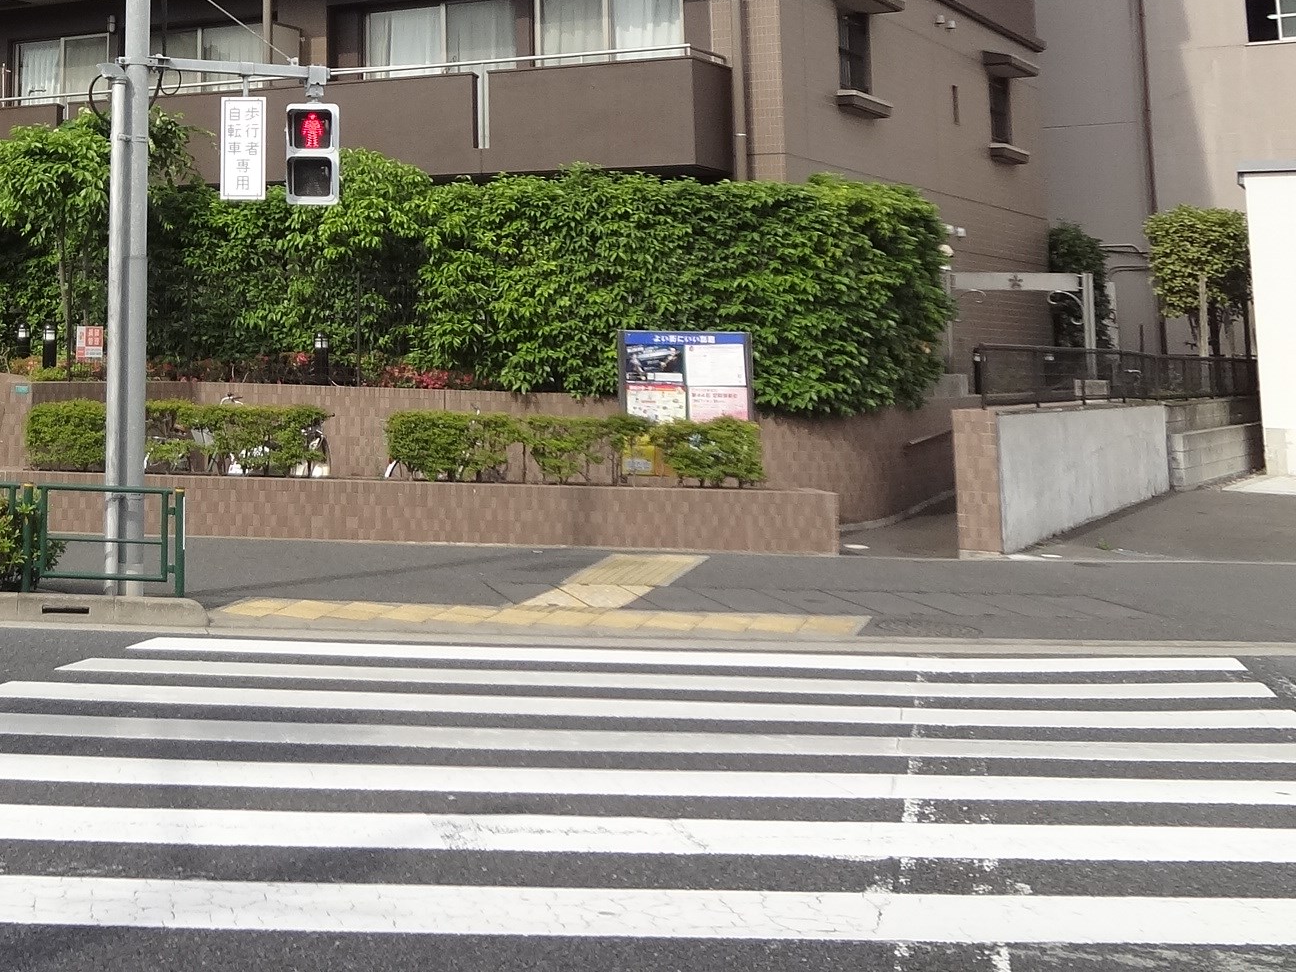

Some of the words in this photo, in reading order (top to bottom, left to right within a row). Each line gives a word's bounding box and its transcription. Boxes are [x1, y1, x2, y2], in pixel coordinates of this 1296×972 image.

[227, 106, 242, 155] 自転車
[245, 105, 260, 155] 歩行者
[236, 158, 251, 191] 専用
